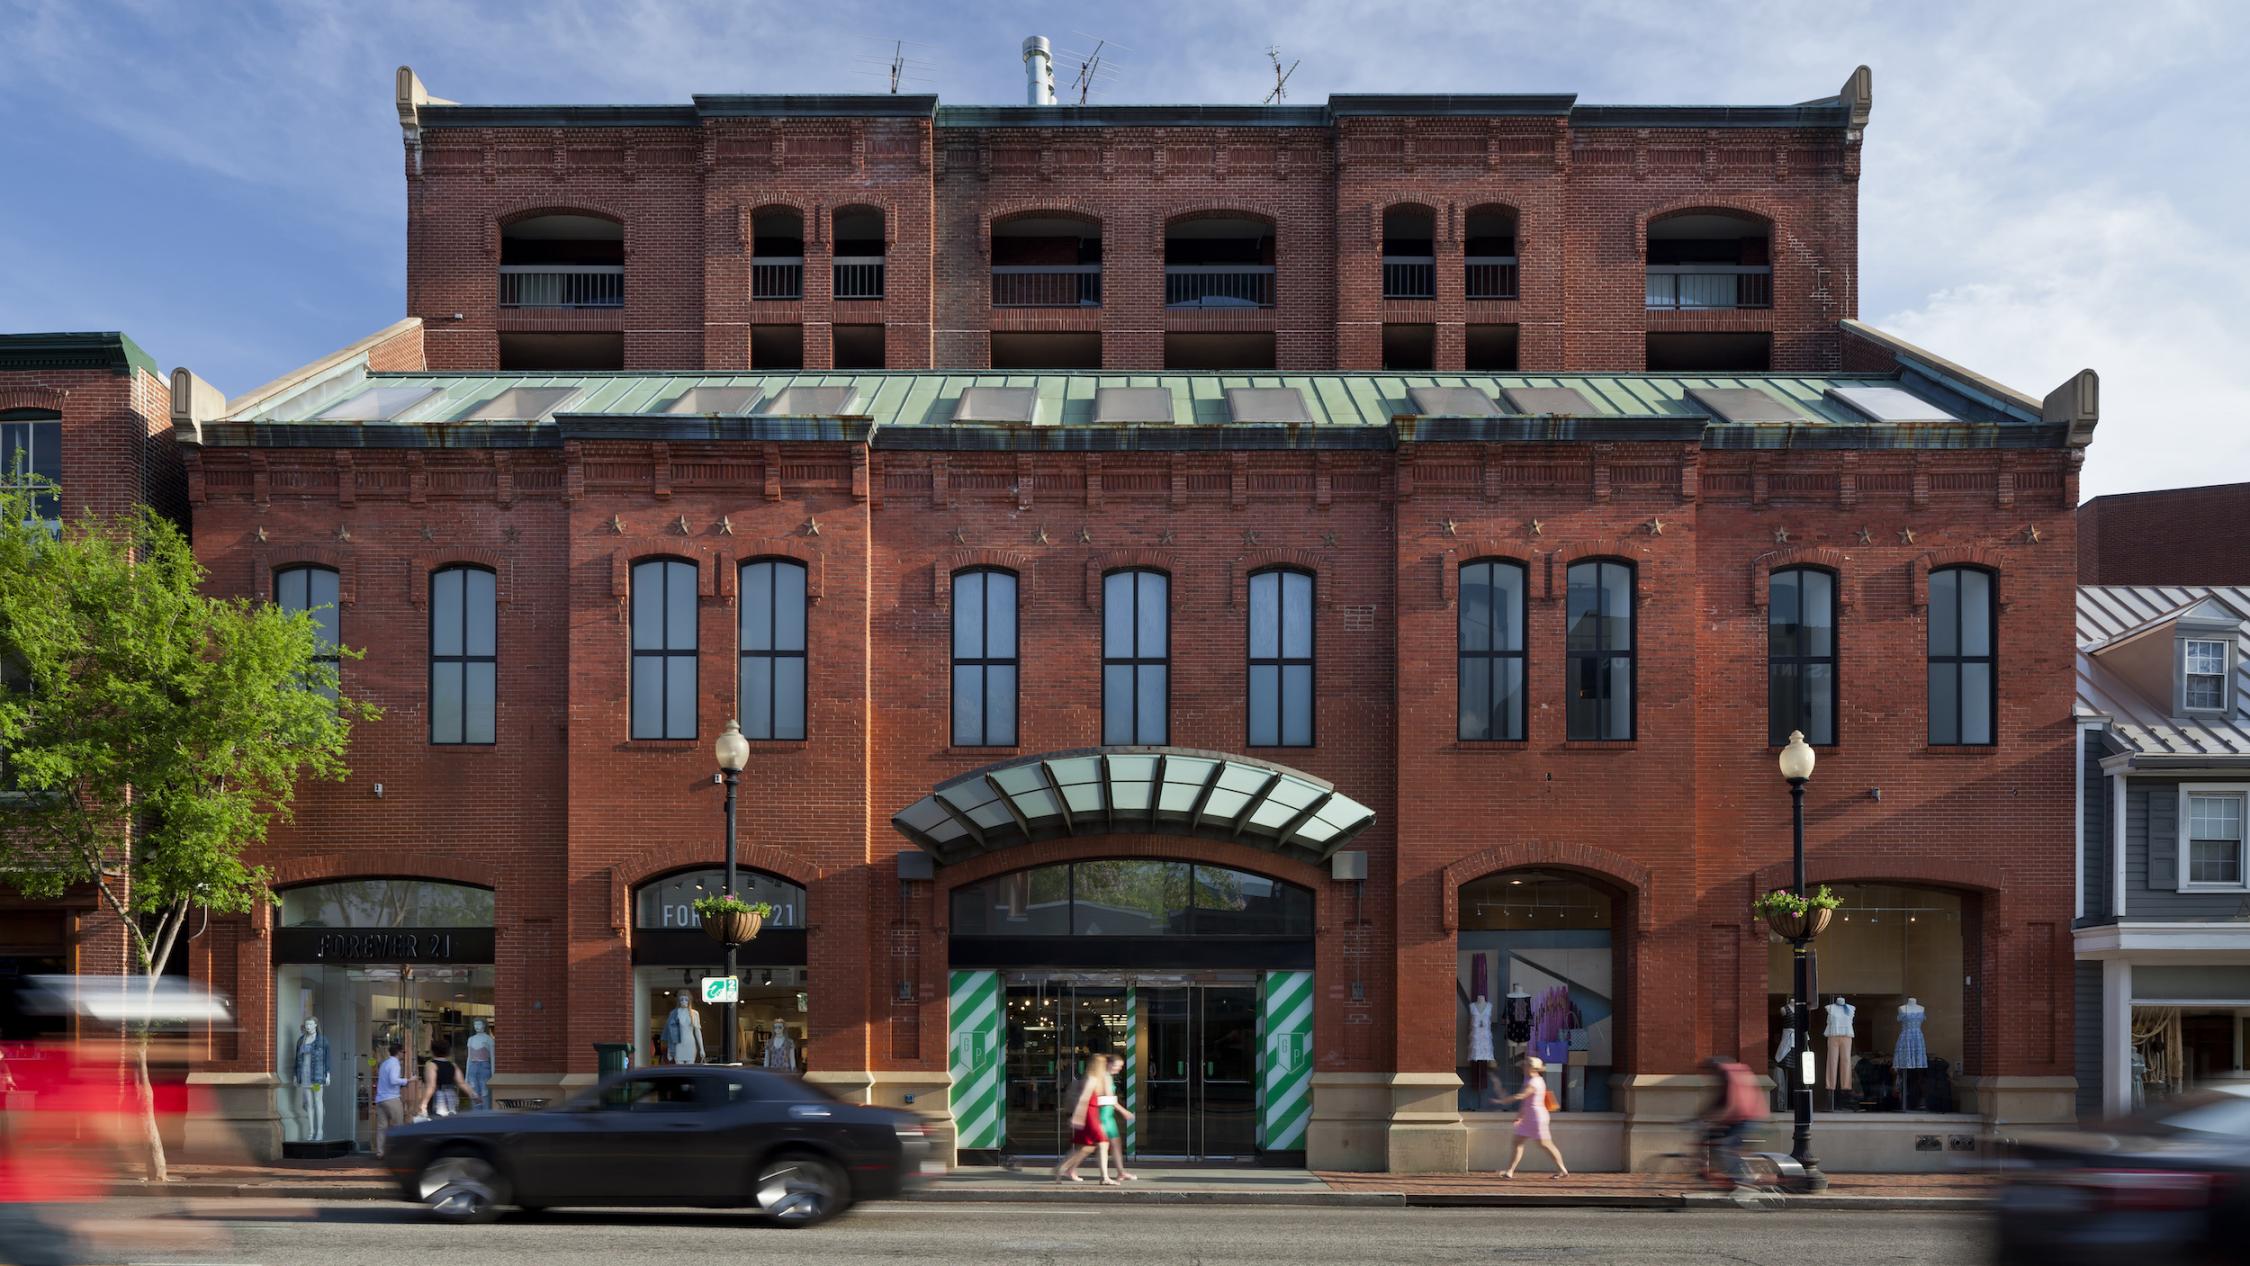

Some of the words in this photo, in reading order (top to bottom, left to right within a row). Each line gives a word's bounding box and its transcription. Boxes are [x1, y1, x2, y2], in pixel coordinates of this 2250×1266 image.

[772, 904, 794, 927] 21
[318, 933, 418, 958] FOREVER
[430, 933, 451, 958] 21
